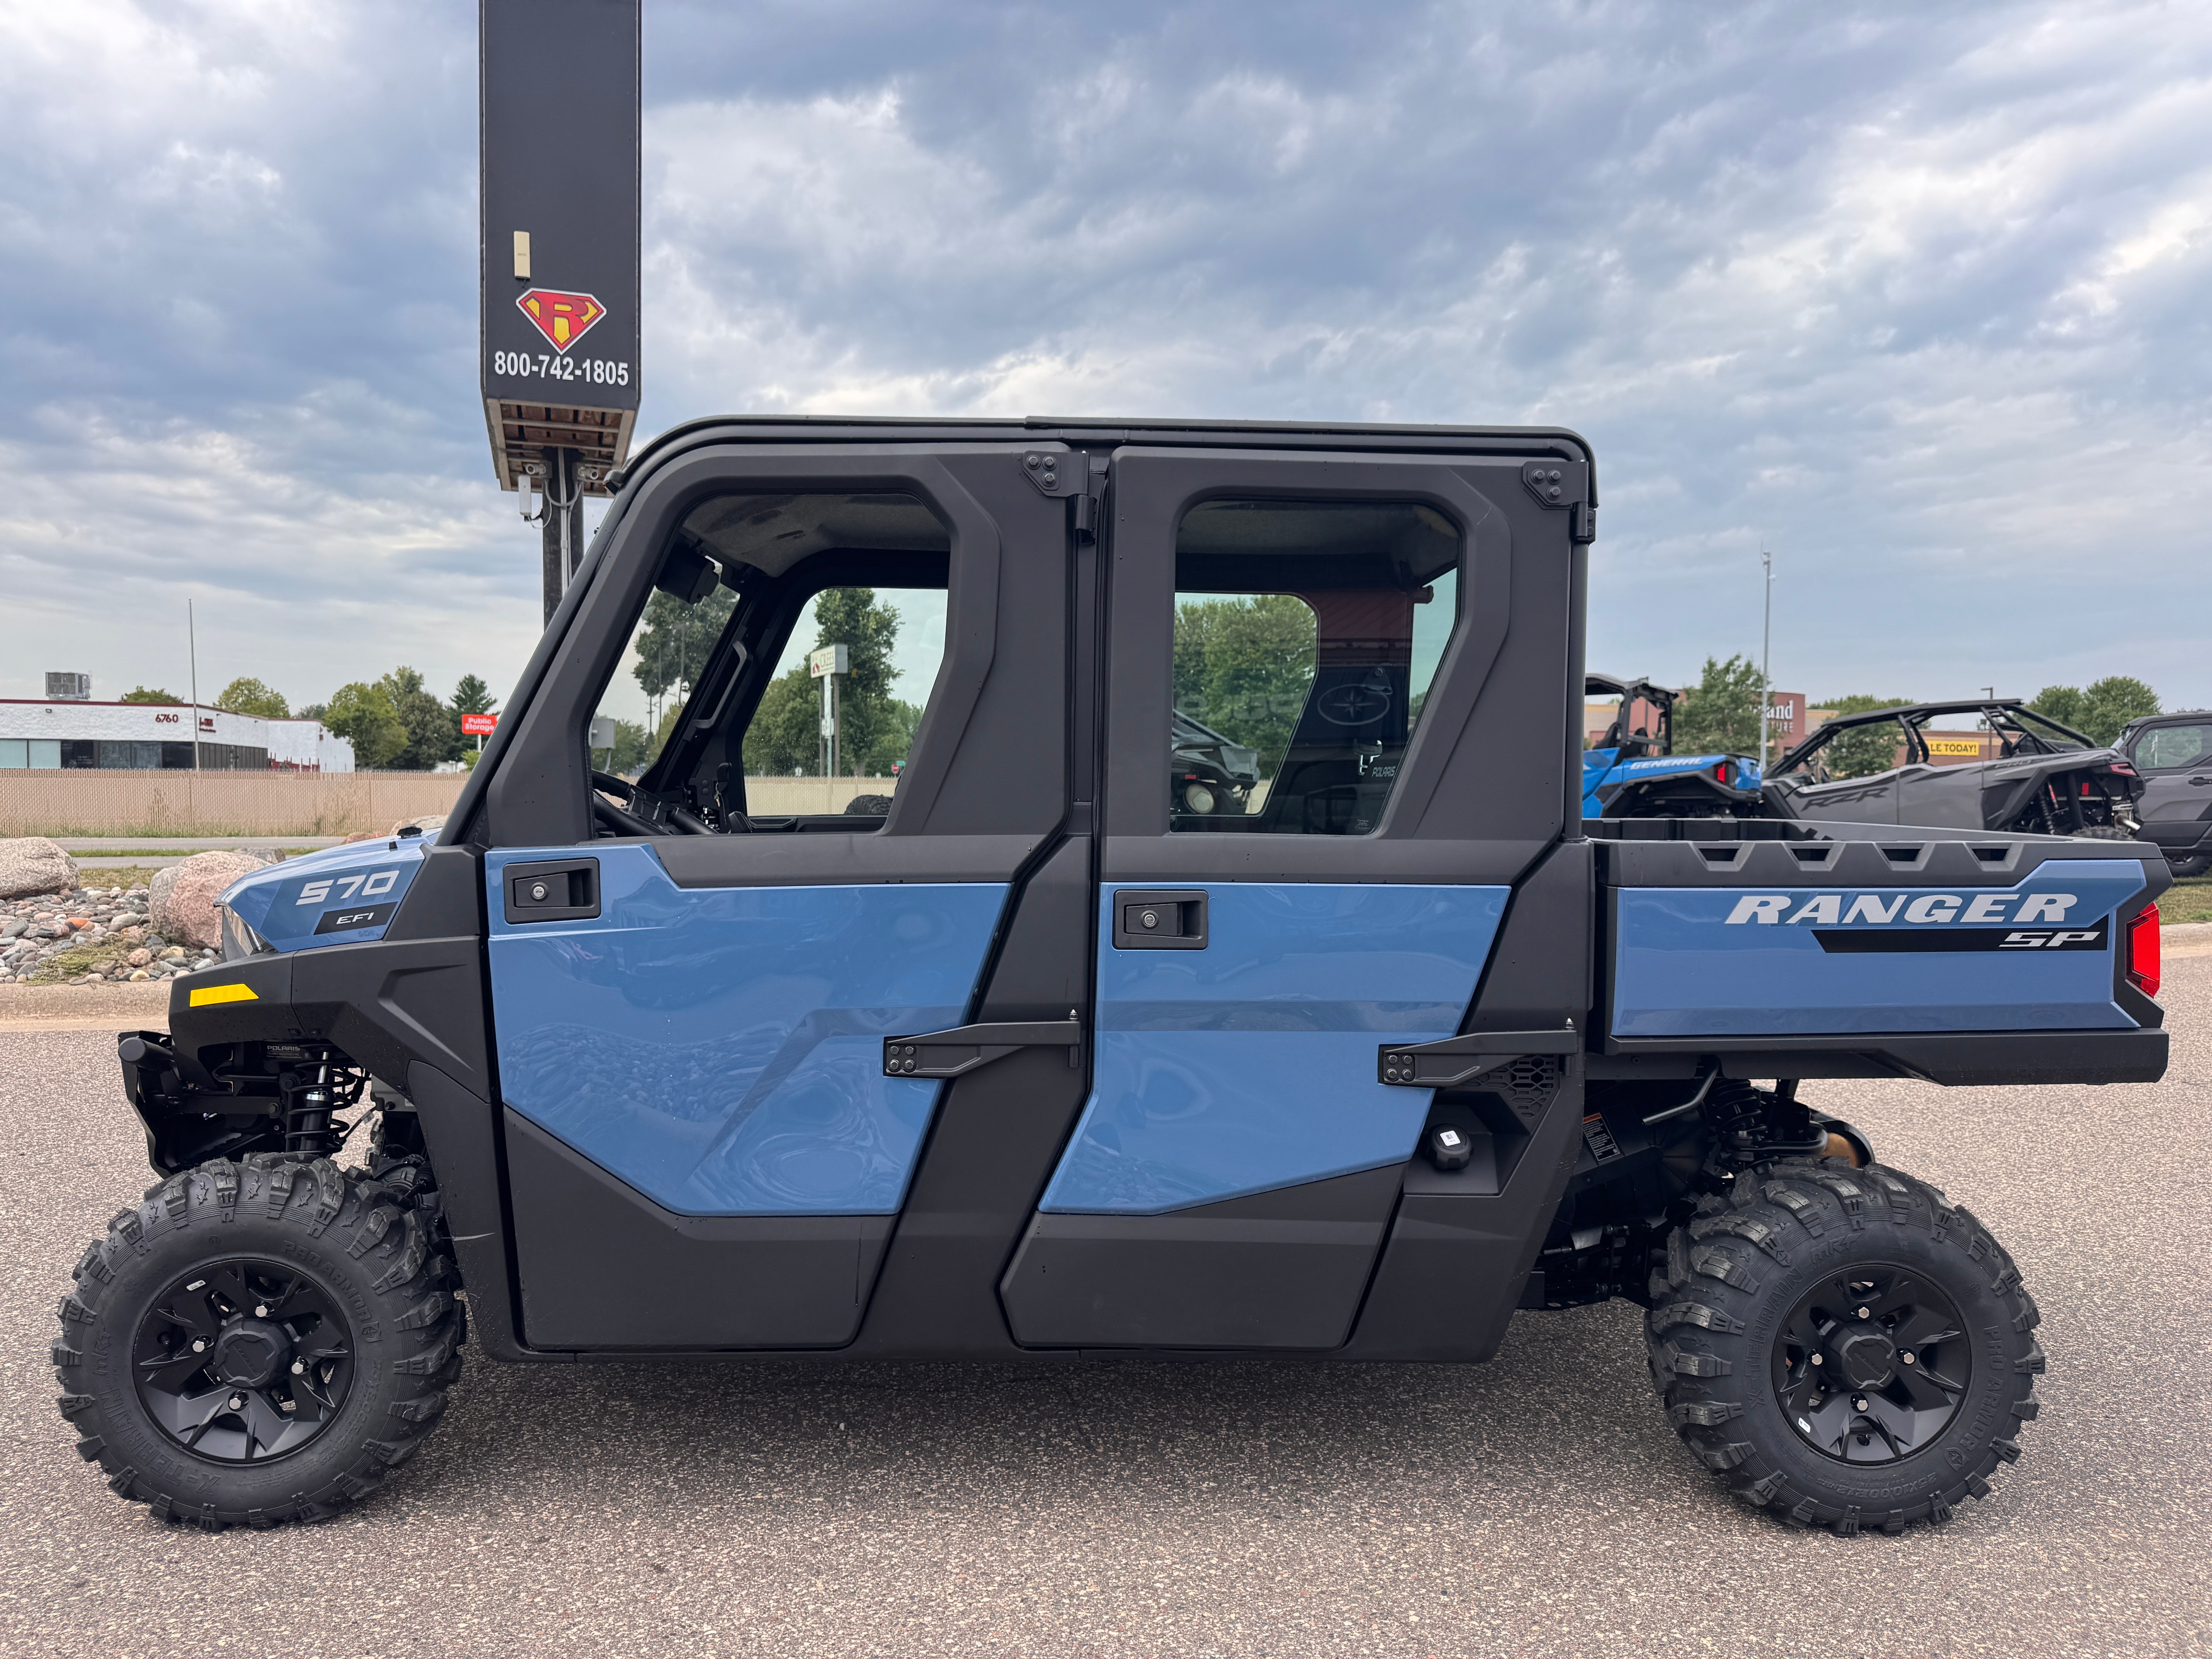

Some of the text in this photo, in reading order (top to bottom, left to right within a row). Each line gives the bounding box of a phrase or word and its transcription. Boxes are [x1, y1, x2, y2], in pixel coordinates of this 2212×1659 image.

[495, 350, 629, 386] 800-742-1805
[155, 713, 179, 723] 6760
[469, 717, 492, 725] Public
[1944, 744, 1977, 753] TODAY!
[1372, 766, 1396, 777] POLARIS
[1630, 757, 1702, 770] GENERAL
[1801, 787, 1889, 812] RZR
[295, 870, 400, 905] 570
[336, 912, 374, 925] EFI
[1724, 894, 2078, 924] RANGER
[1999, 931, 2100, 947] SP
[281, 1240, 371, 1322] PRO ARMOR
[1745, 1266, 1804, 1409] X-TERRAIN
[1959, 1325, 2005, 1453] PRO ARMOR
[99, 1388, 222, 1496] X-TERRAIN
